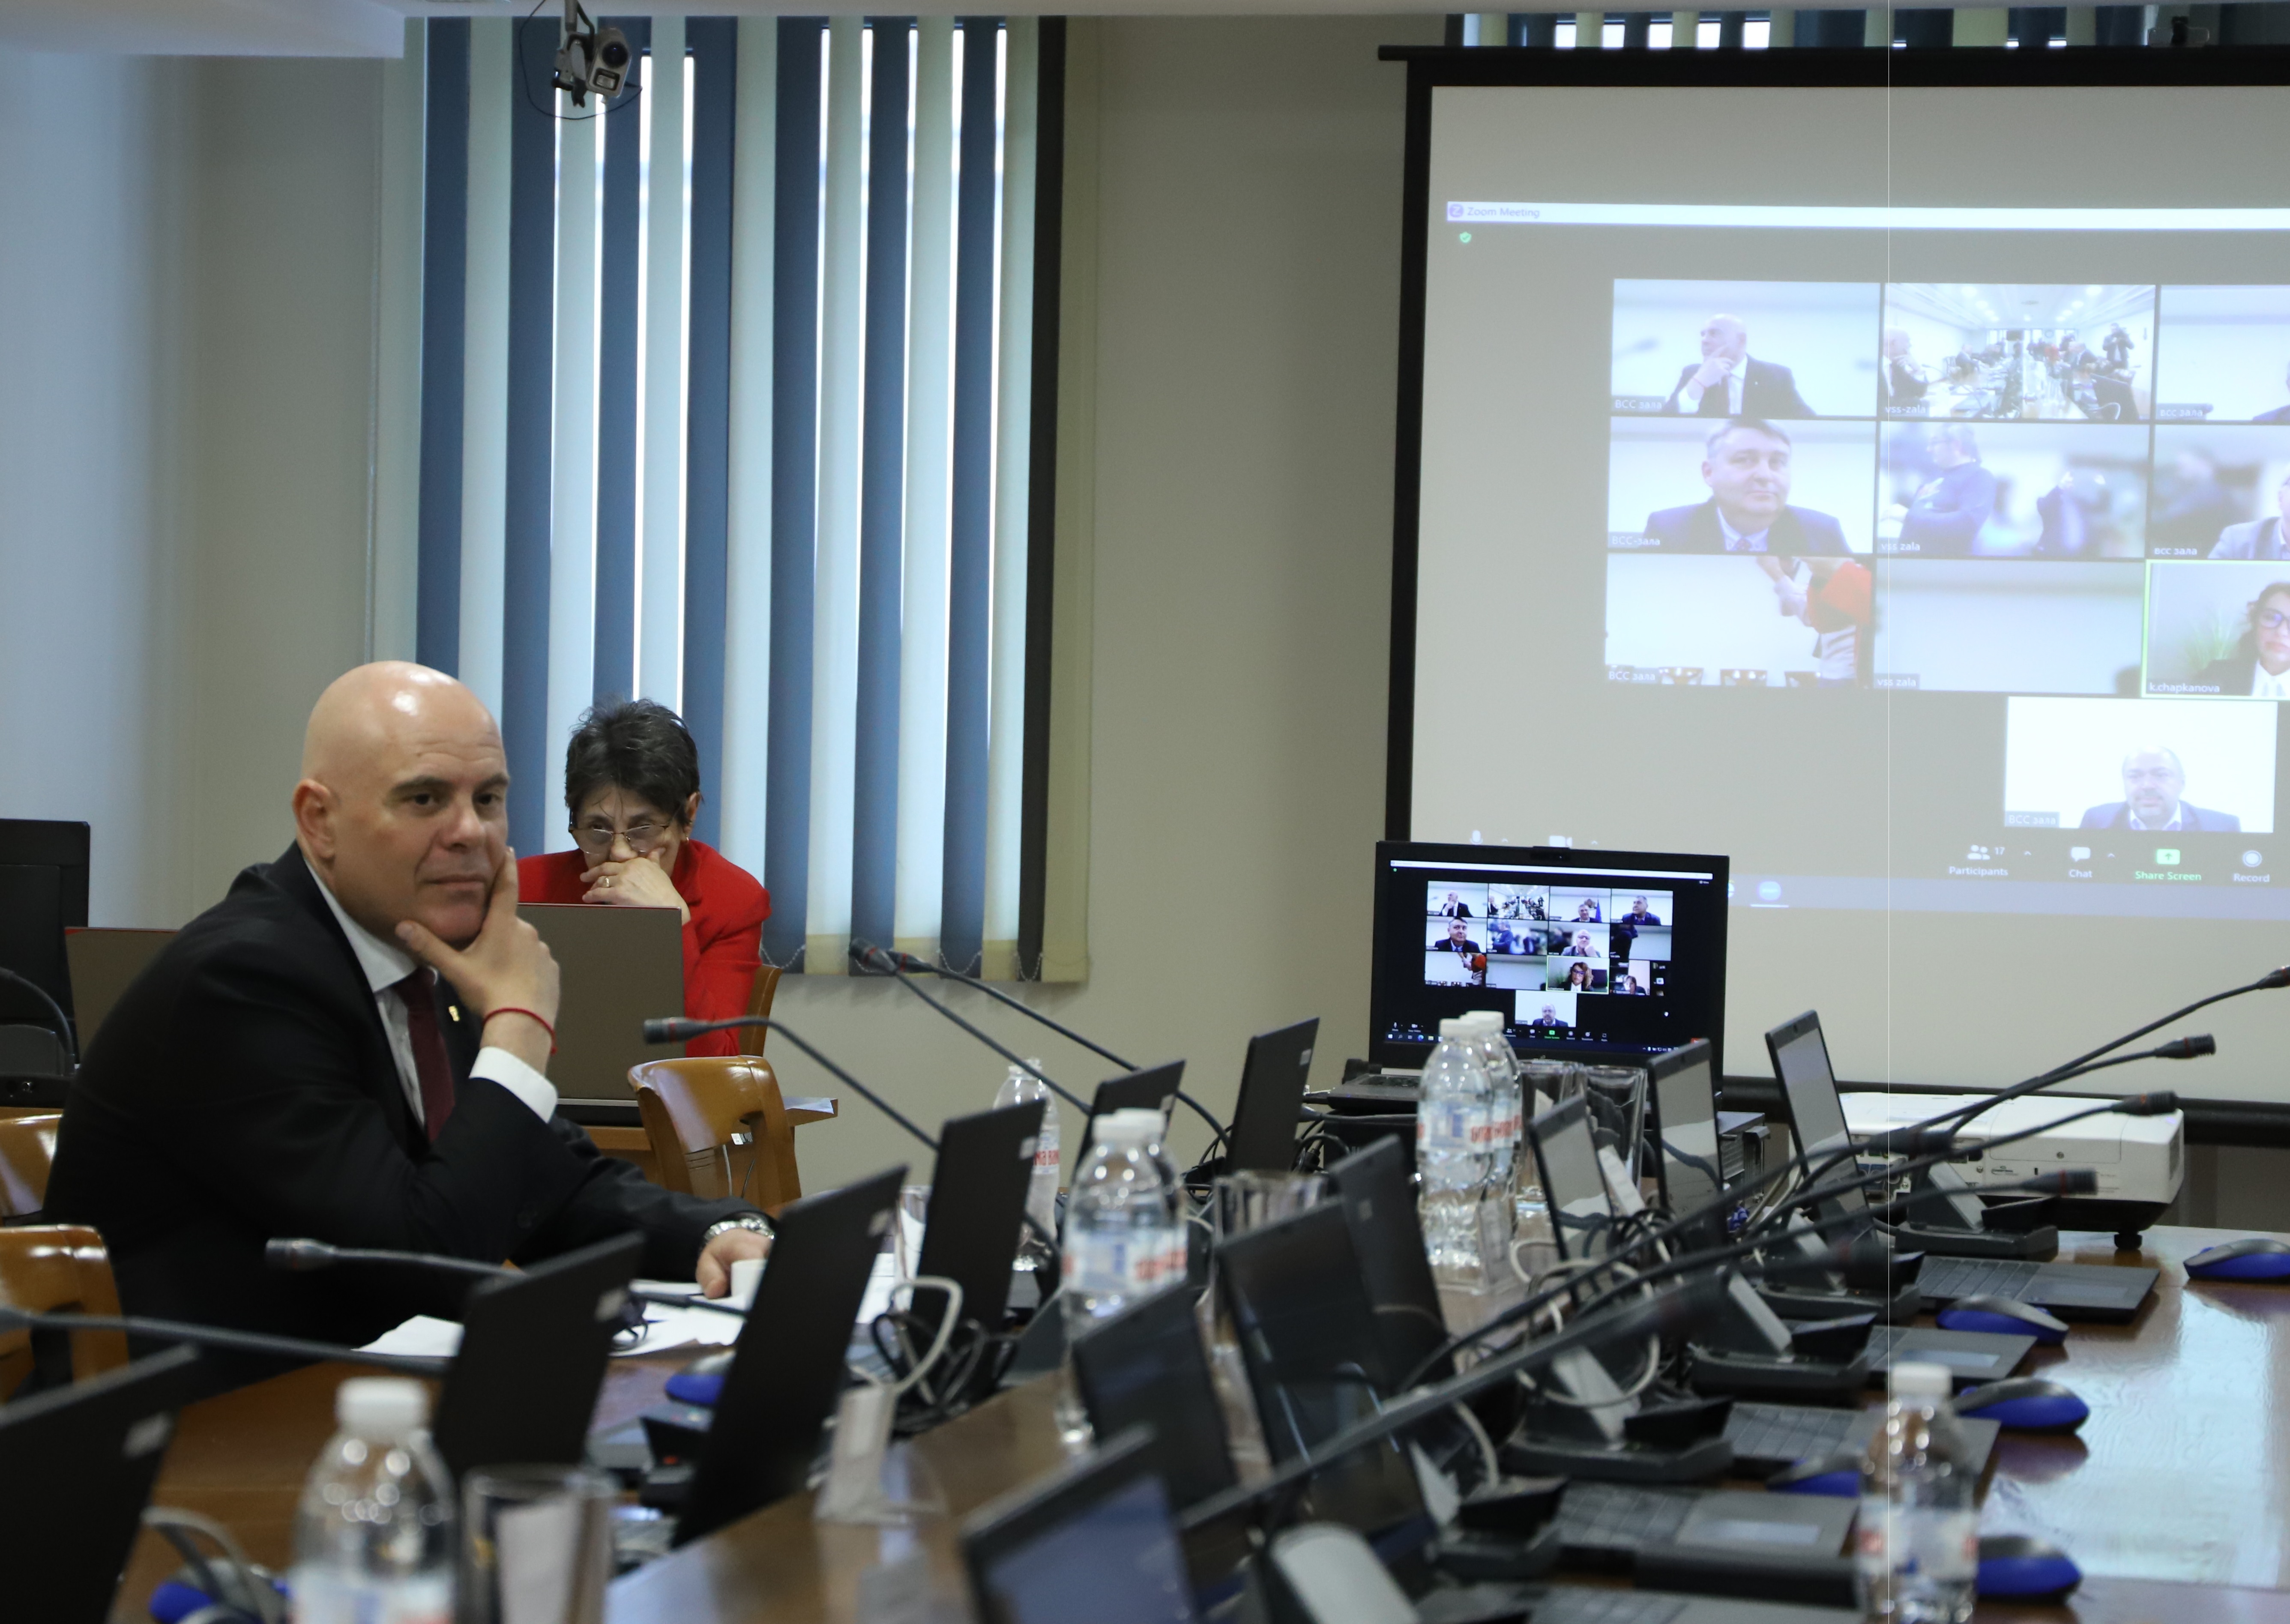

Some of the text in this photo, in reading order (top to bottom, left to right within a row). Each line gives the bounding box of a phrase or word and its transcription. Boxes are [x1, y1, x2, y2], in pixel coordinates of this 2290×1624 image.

[1467, 206, 1540, 219] Zoom Meeting
[1885, 404, 1926, 413] vss-zala
[1900, 541, 1920, 551] zala
[1896, 677, 1916, 686] zala
[2149, 682, 2220, 694] k.chapkanova
[1994, 846, 2006, 855] 17
[1949, 866, 2009, 877] Participants
[2069, 869, 2093, 878] Chat
[2135, 870, 2202, 881] Share Screen
[2233, 873, 2270, 882] Record
